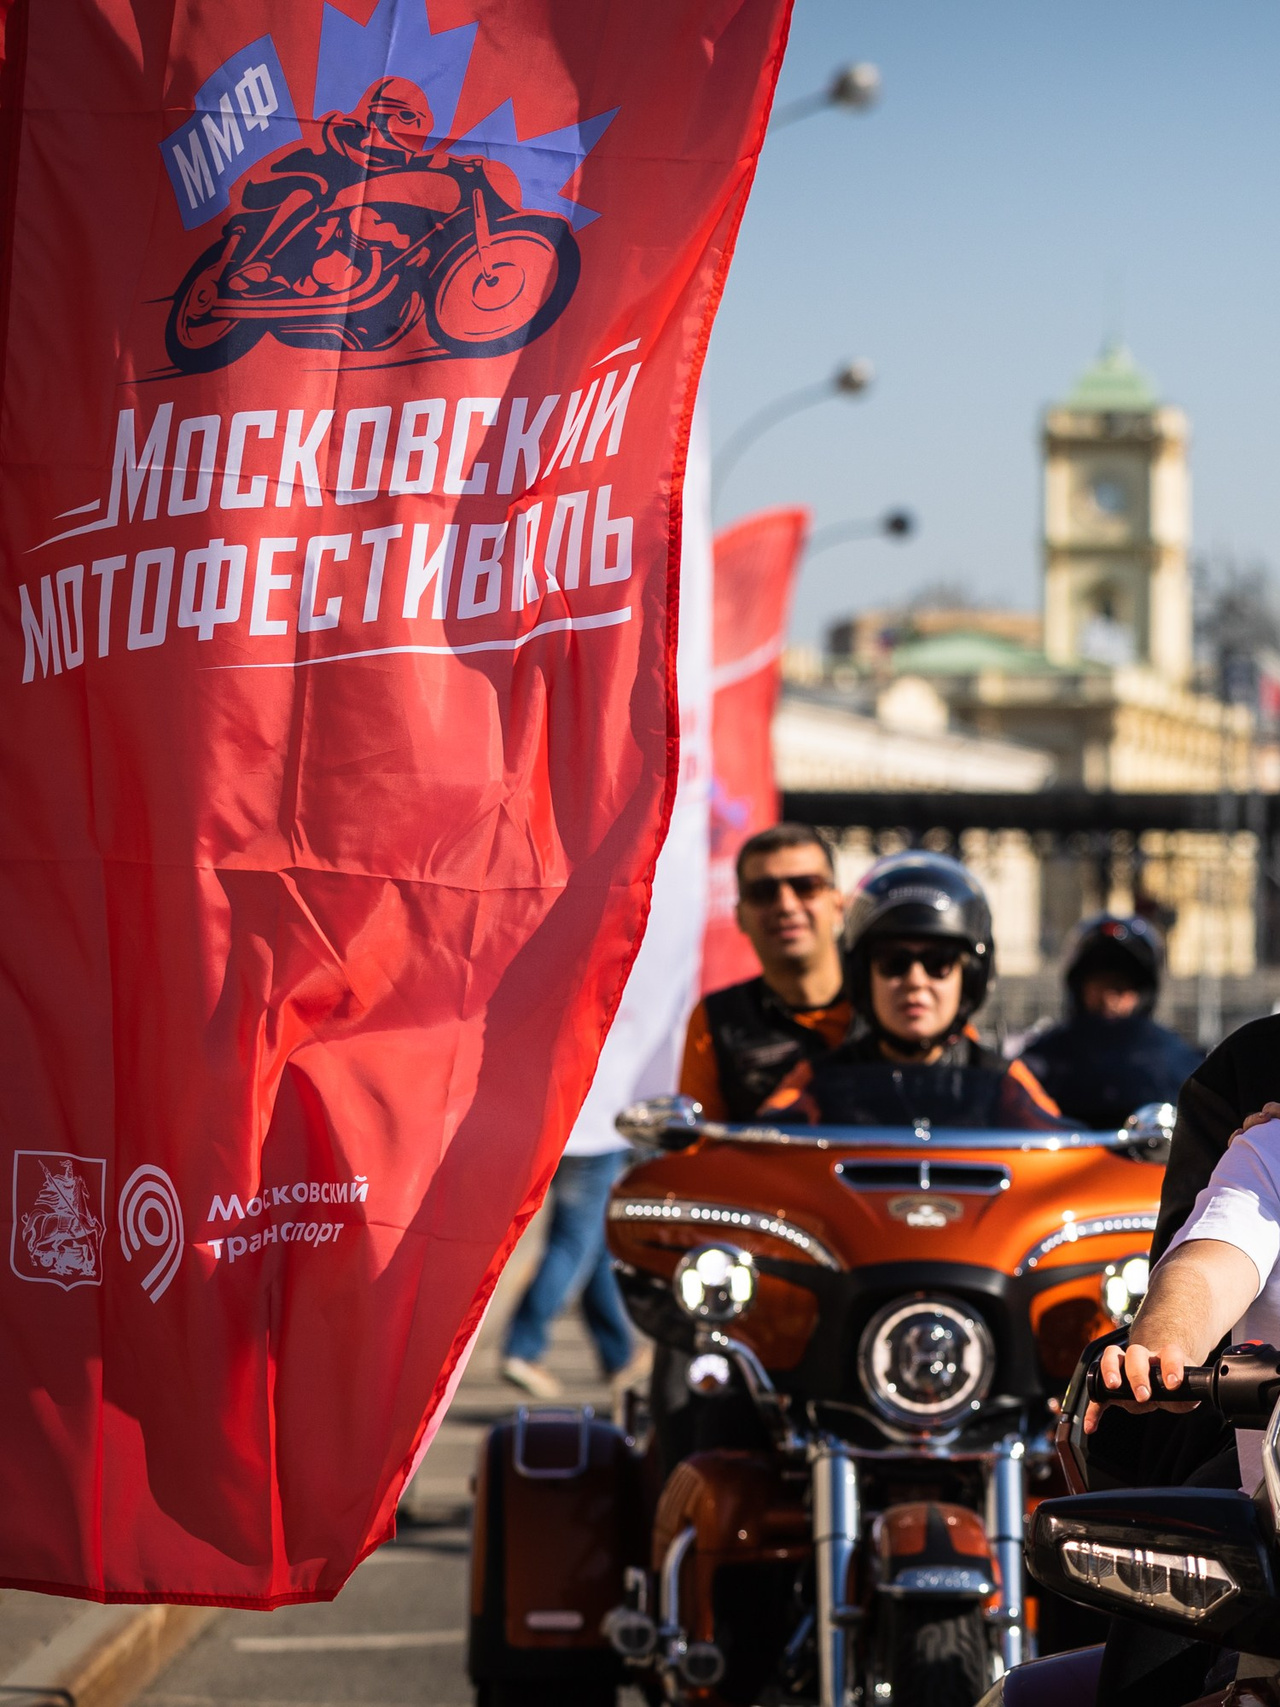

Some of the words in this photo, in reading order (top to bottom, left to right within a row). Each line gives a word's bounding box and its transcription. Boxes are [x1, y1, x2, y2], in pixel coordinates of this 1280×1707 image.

[171, 61, 279, 209] ММФ
[19, 484, 634, 685] МОТОФЕСТИВАЛЬ
[206, 1220, 344, 1263] транспорт
[207, 1174, 370, 1222] Московский
